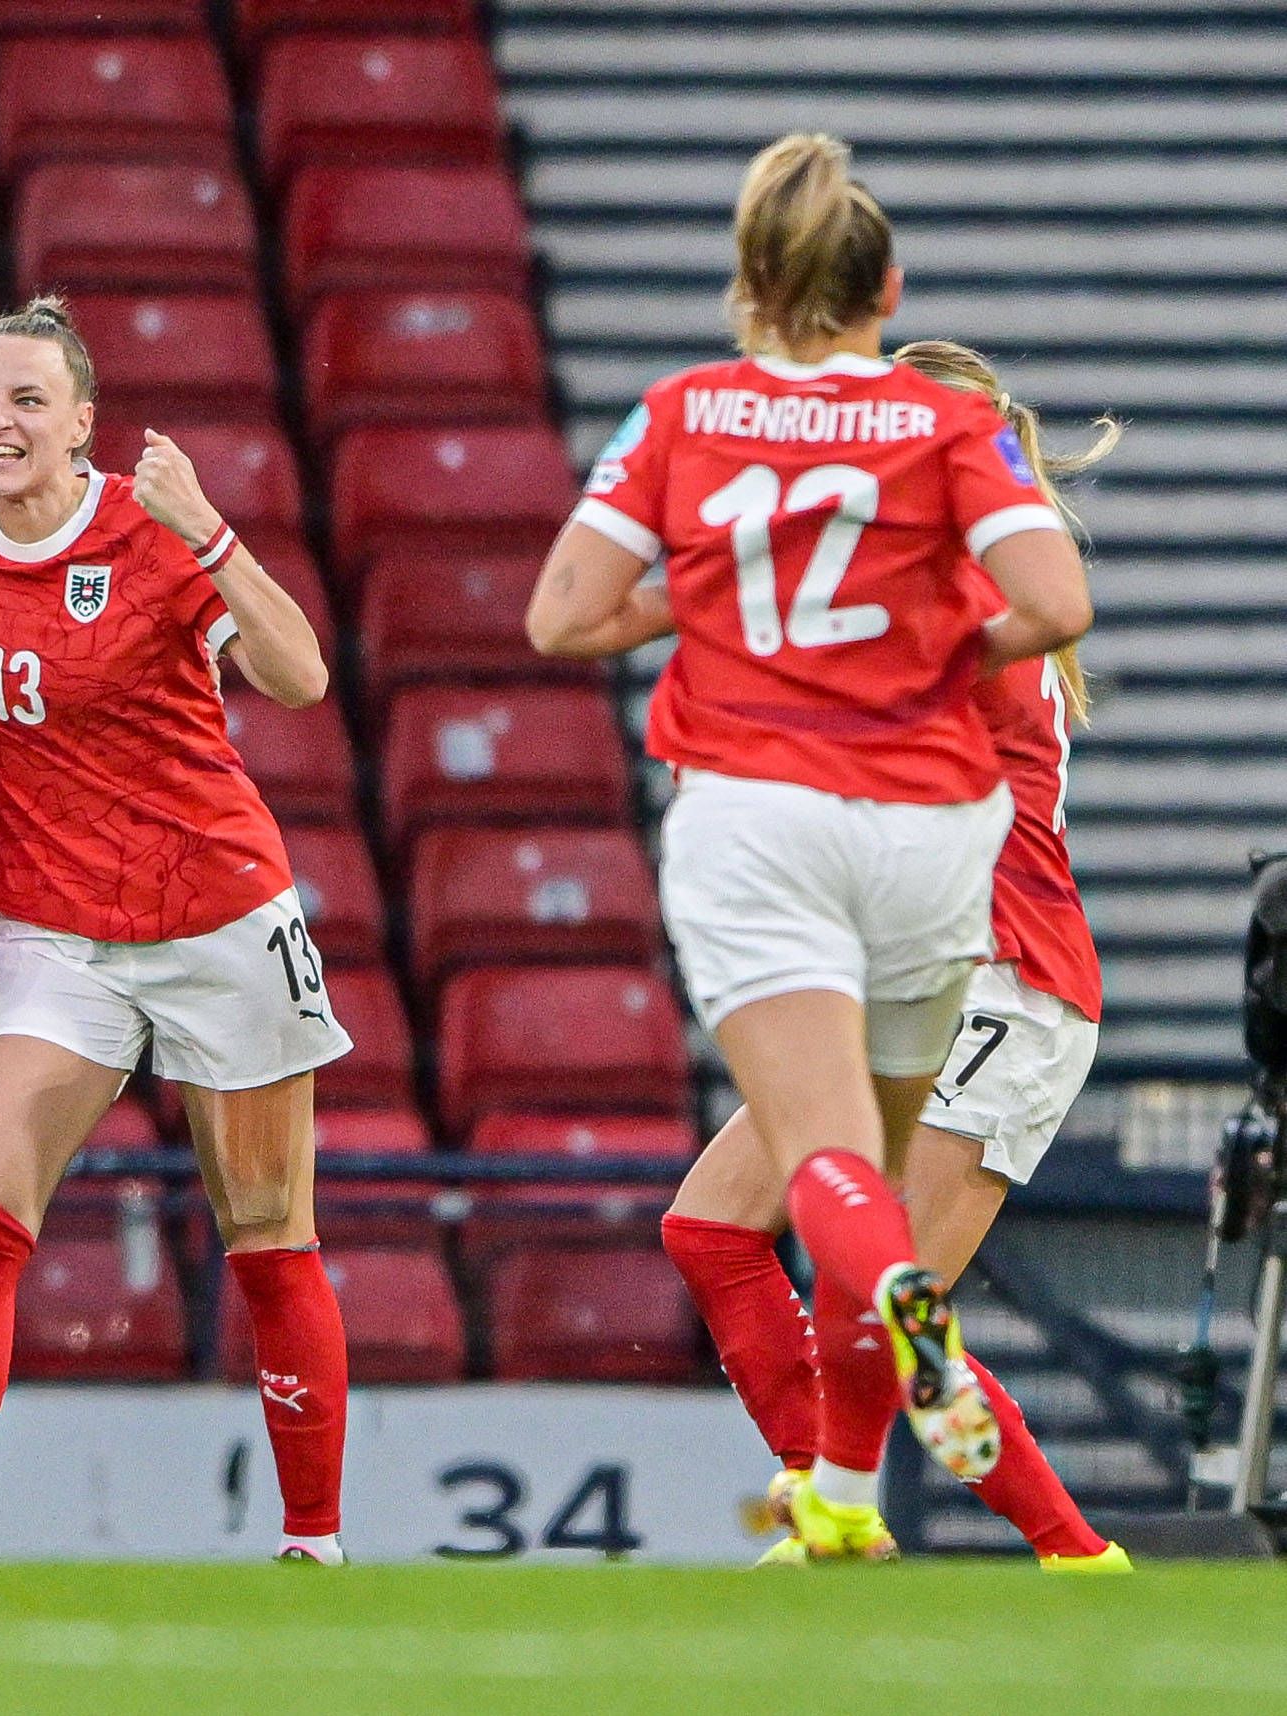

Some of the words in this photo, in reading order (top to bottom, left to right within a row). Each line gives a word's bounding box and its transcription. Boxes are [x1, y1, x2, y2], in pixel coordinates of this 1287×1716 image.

[684, 388, 937, 443] WIENROITHER
[699, 464, 890, 657] 12
[266, 917, 321, 1003] 13
[433, 1461, 644, 1561] 34
